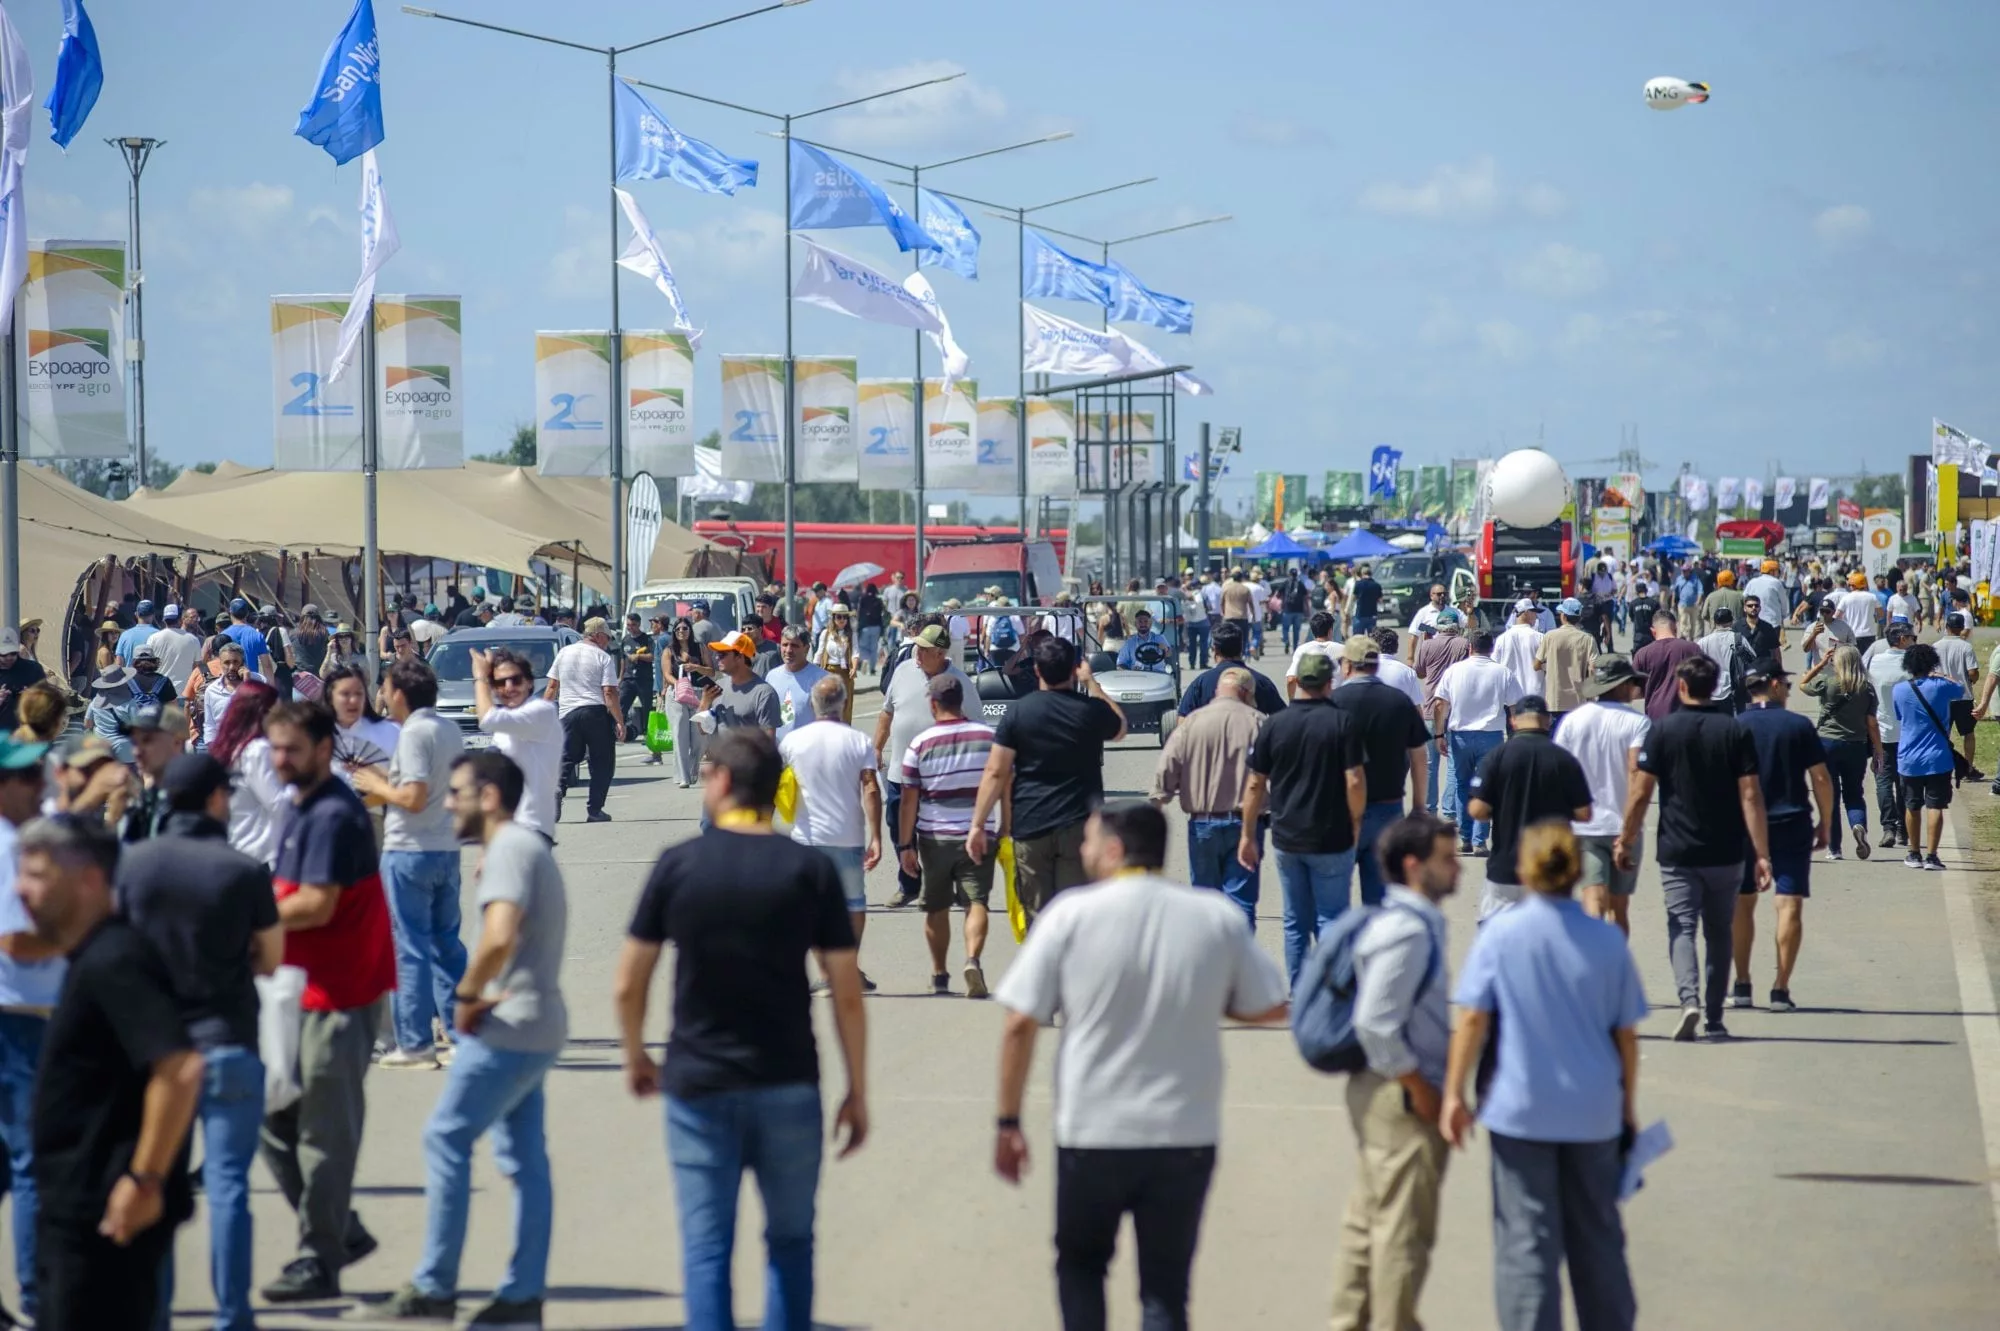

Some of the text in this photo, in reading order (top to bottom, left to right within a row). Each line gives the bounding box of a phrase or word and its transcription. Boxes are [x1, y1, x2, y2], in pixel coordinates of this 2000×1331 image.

[320, 65, 371, 102] San
[28, 360, 110, 379] Expoagro
[78, 382, 111, 397] agro
[385, 391, 452, 406] Expoagro
[425, 409, 452, 420] agro
[630, 409, 685, 424] Expoagro
[662, 424, 685, 434] agro
[801, 424, 850, 436] Expoagro
[1877, 533, 1886, 546] 1
